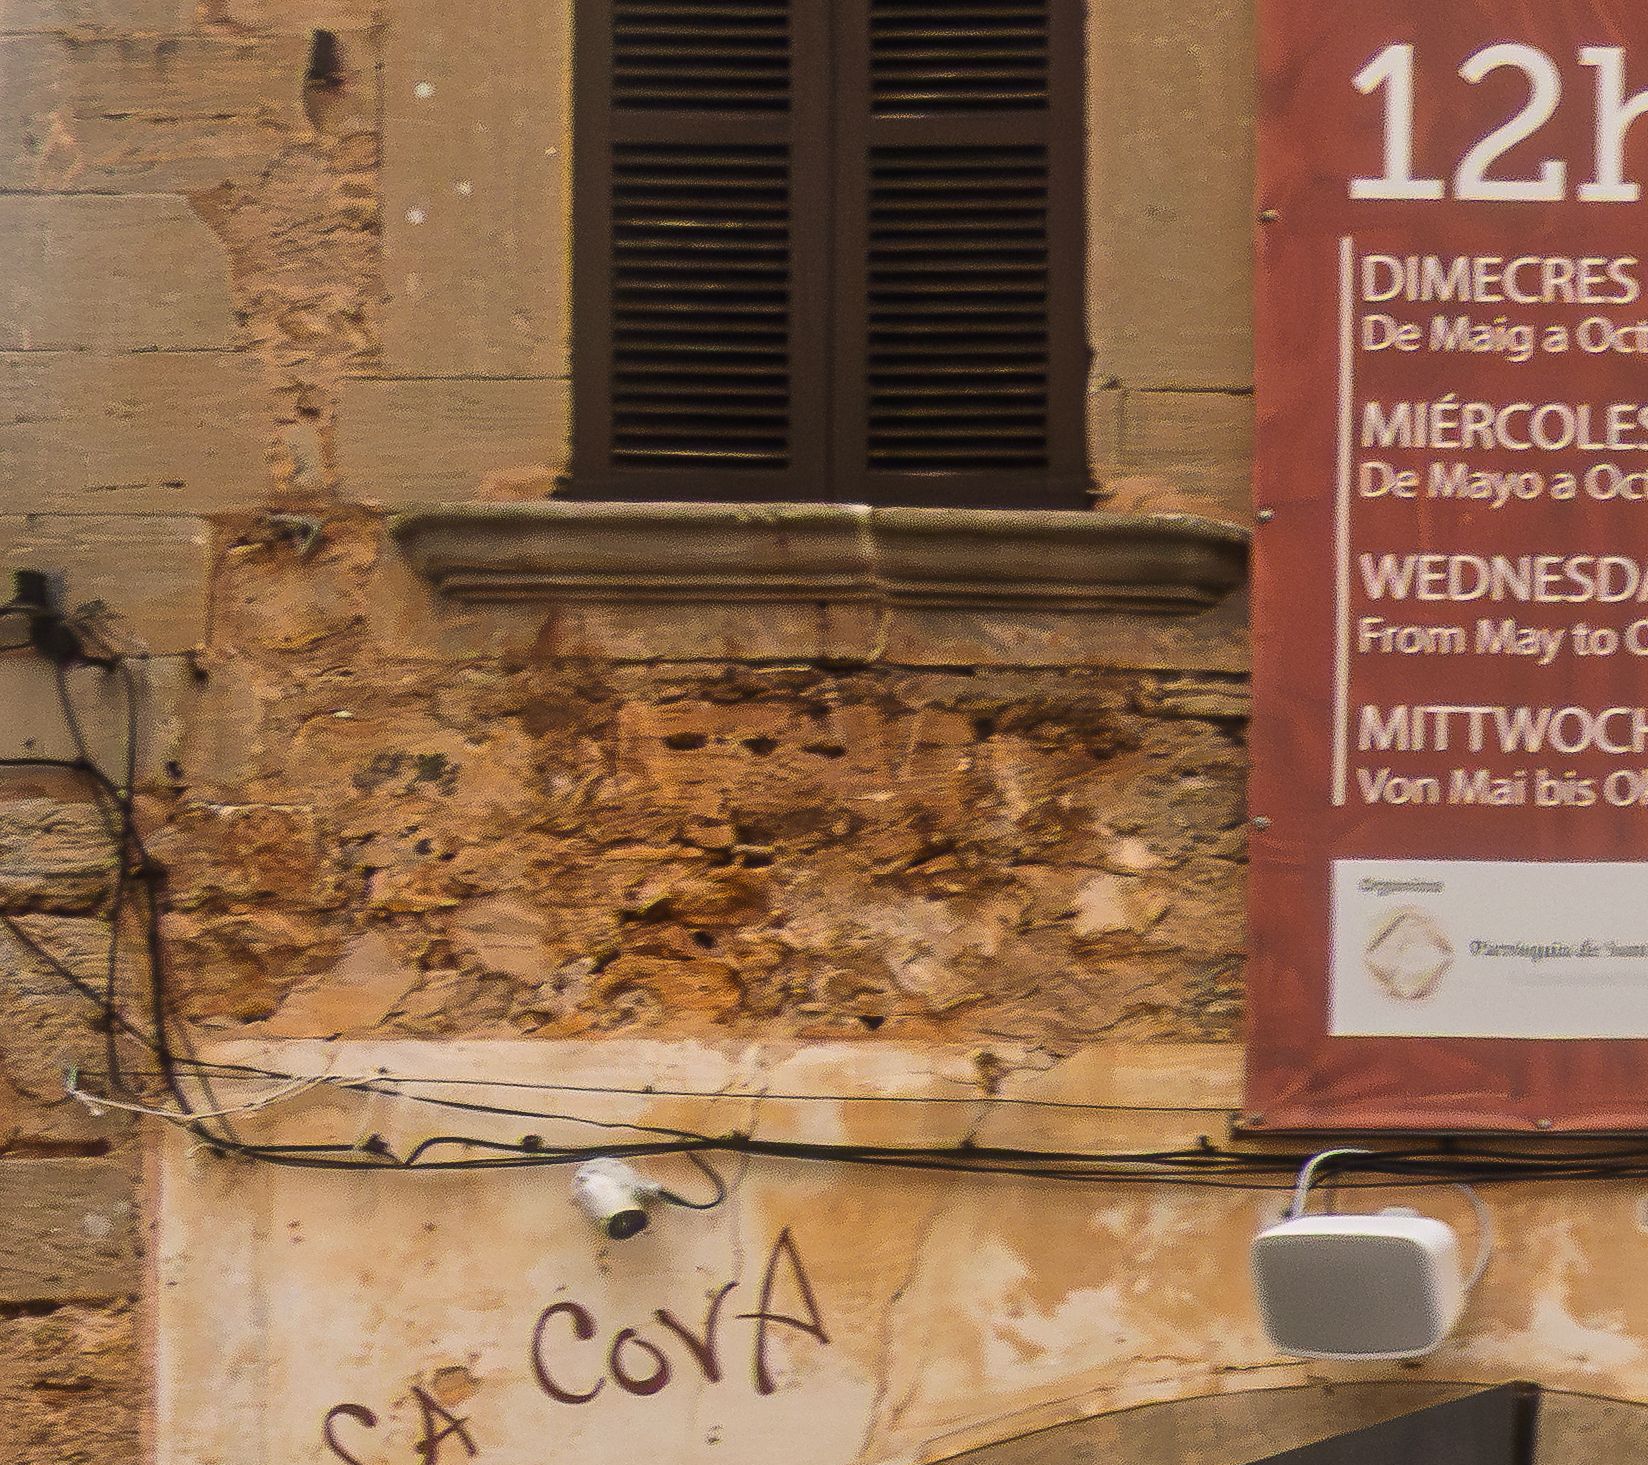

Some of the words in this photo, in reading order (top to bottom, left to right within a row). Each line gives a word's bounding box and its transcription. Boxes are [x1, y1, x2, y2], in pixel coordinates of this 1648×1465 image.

[1361, 254, 1641, 306] DIMECRES
[1361, 314, 1422, 352] De
[1429, 315, 1535, 363] Maig
[1542, 325, 1569, 354] a
[1359, 461, 1419, 499] De
[1428, 463, 1543, 507] Mayo
[1550, 472, 1578, 501] a
[1358, 616, 1466, 656] From
[1475, 618, 1565, 665] May
[1572, 623, 1618, 657] to
[1357, 769, 1441, 805] Von
[1449, 769, 1527, 806] Mai
[1535, 769, 1597, 807] bis
